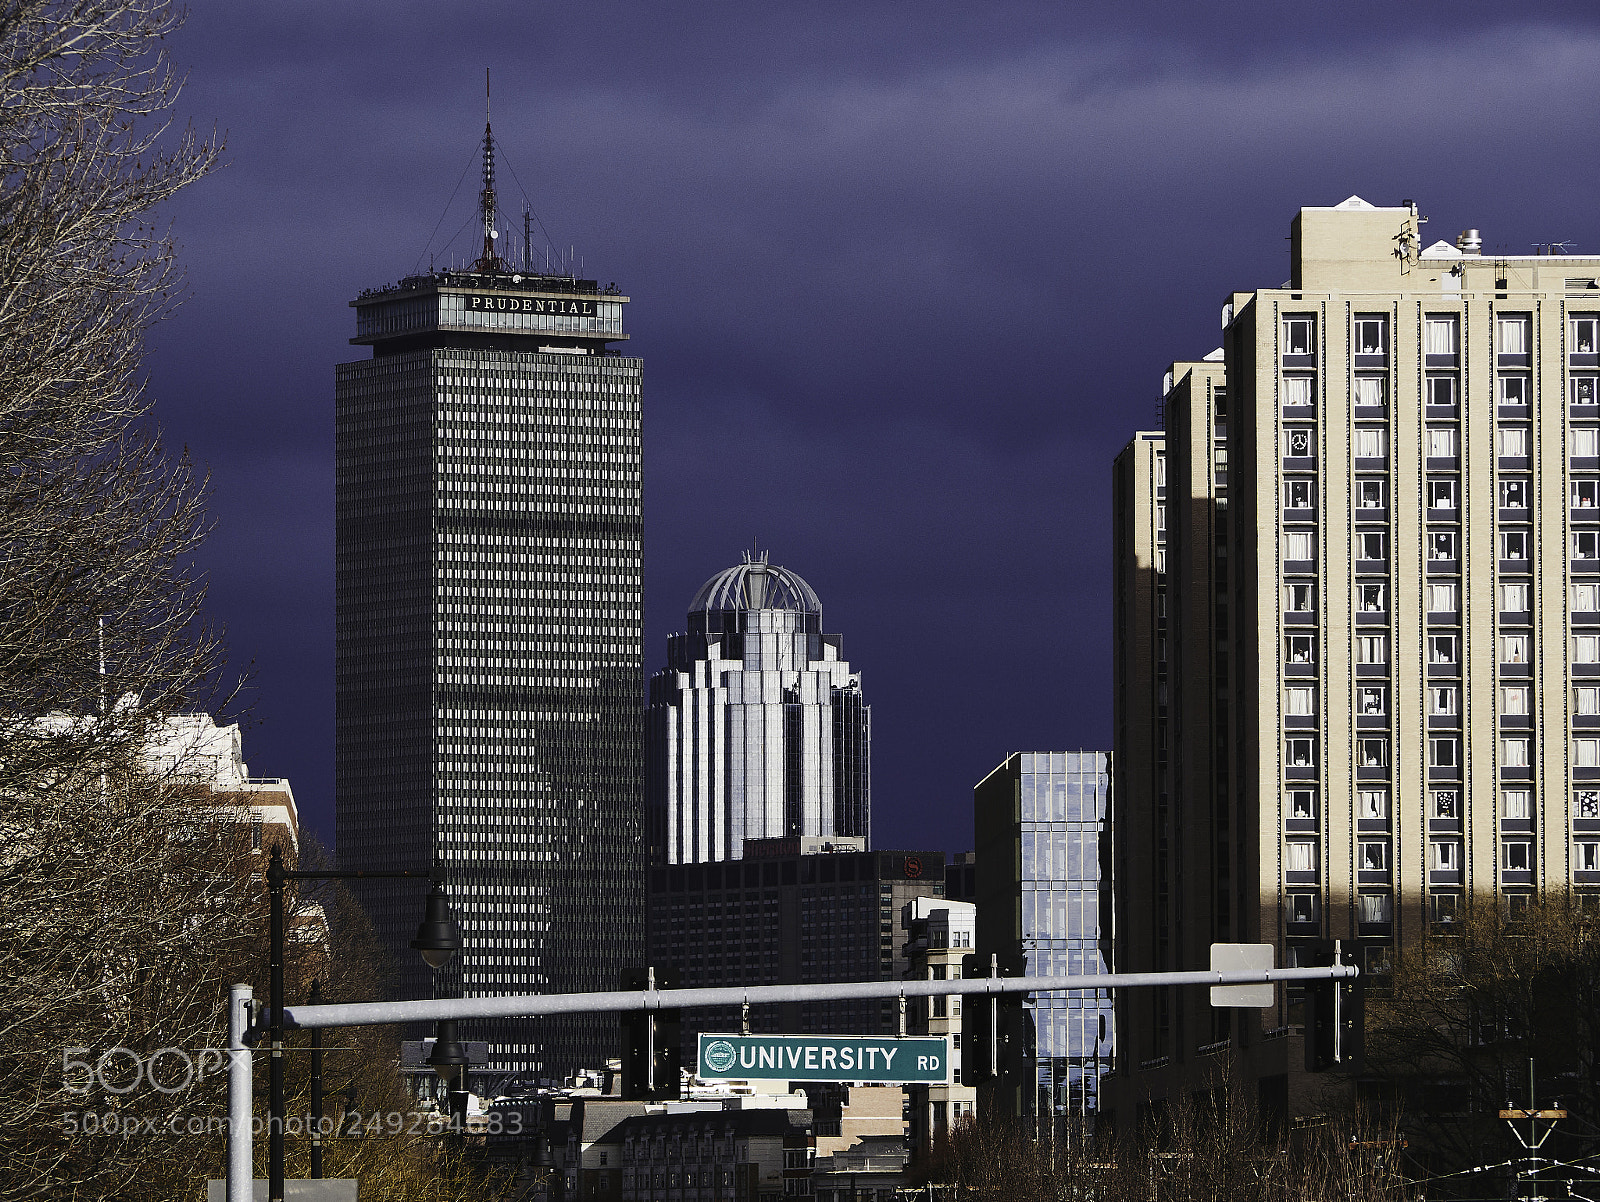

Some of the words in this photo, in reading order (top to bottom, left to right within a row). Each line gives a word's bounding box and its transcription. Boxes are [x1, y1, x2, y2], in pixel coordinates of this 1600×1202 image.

[471, 297, 592, 314] PRUDENTIAL
[739, 1045, 898, 1071] UNIVERSITY
[917, 1055, 940, 1071] RD
